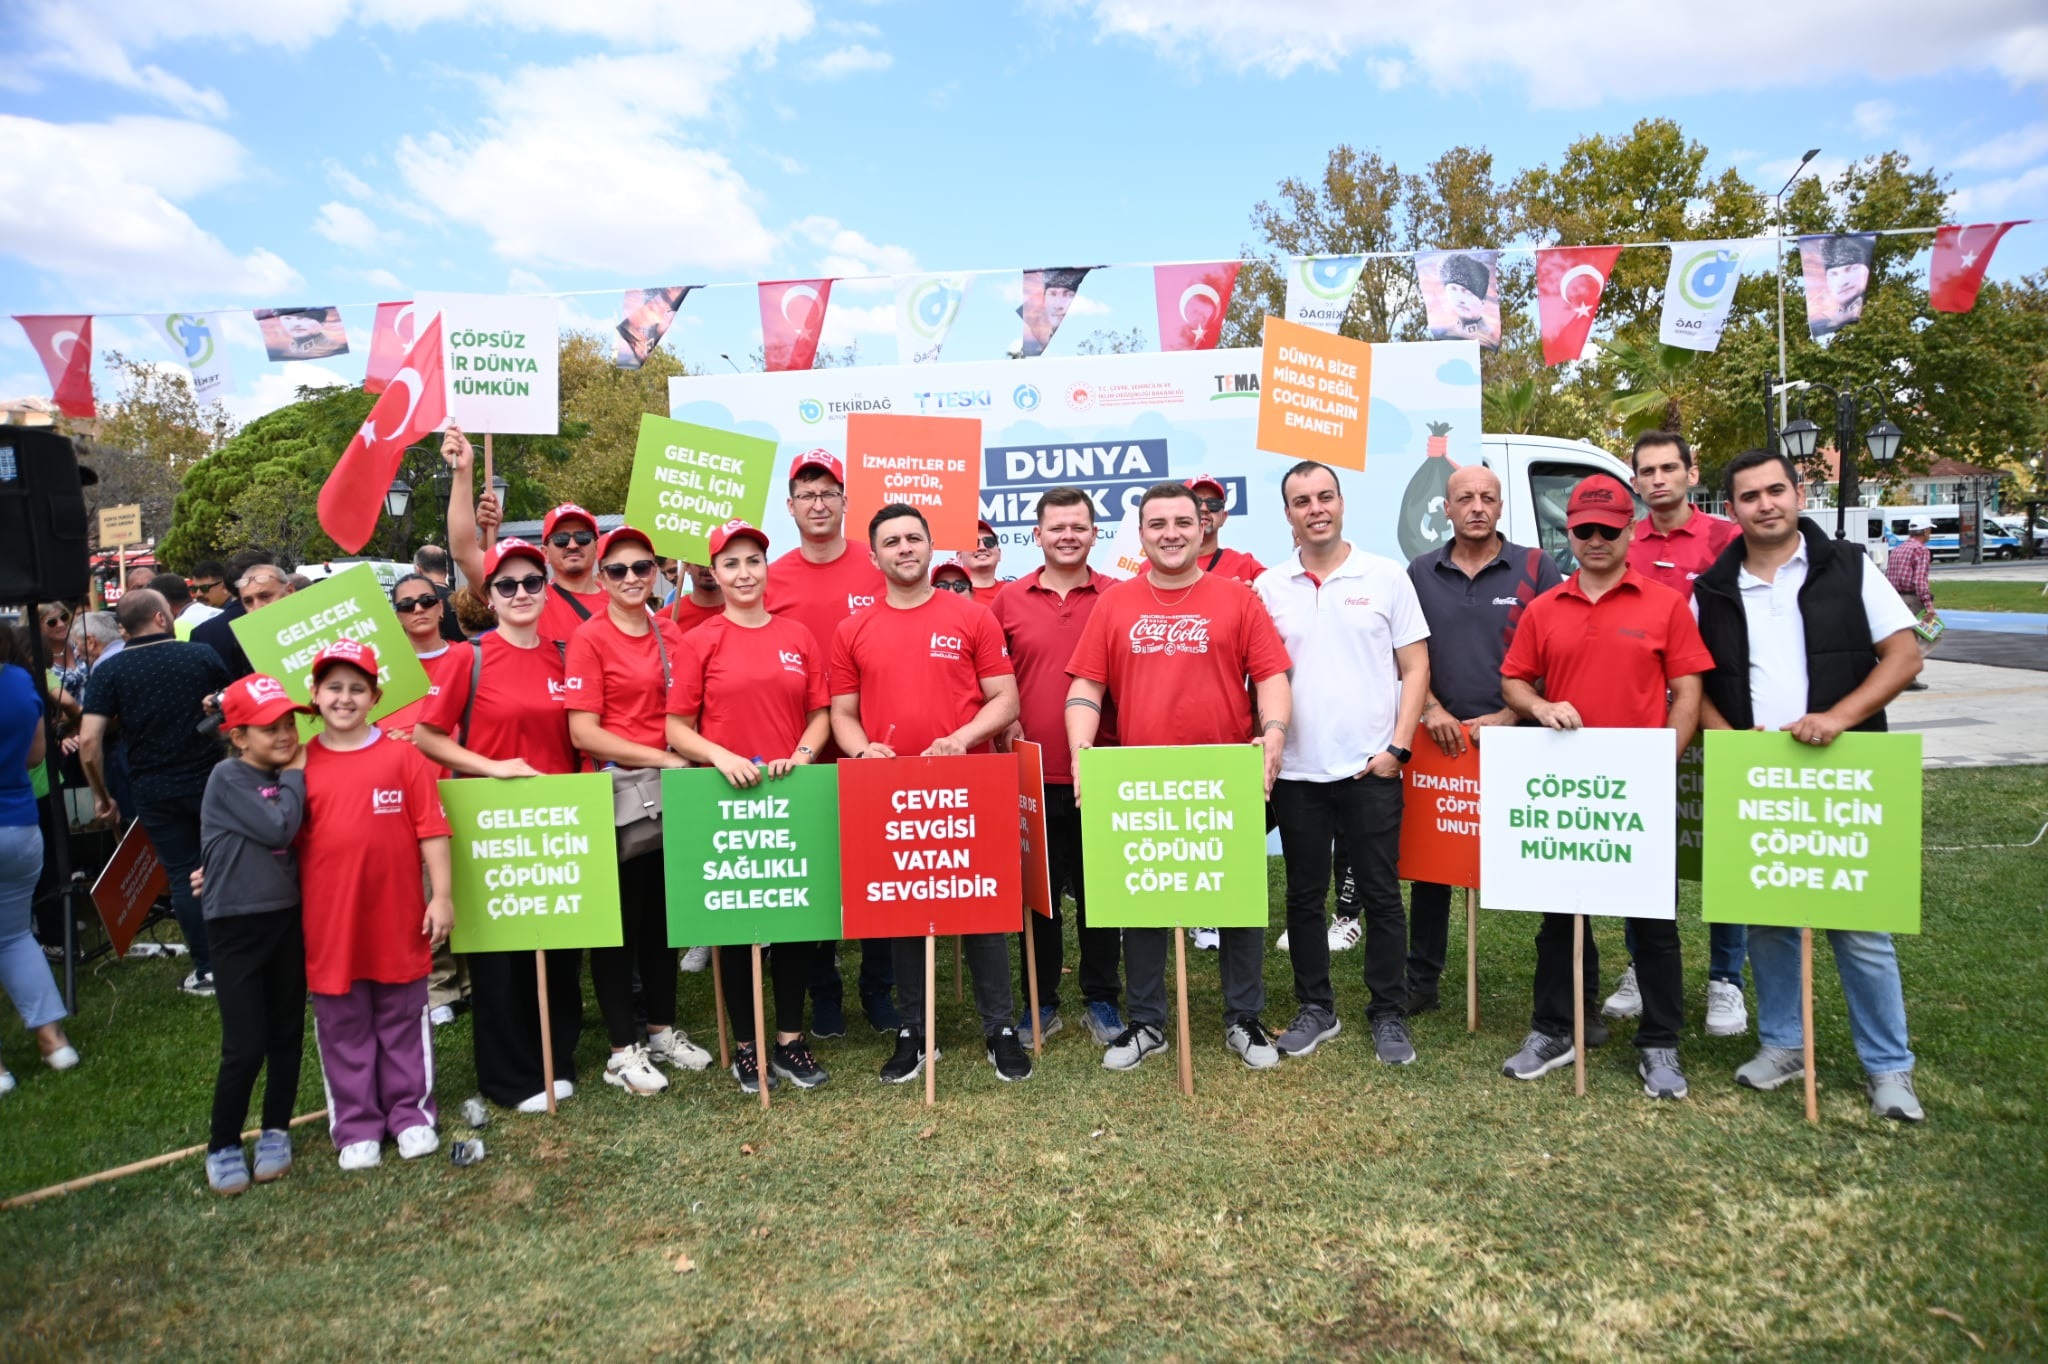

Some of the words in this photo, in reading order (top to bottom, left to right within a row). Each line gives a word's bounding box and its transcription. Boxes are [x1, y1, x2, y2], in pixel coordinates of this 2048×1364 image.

[450, 329, 526, 349] ÇÖPSÜZ
[473, 353, 538, 373] DÜNYA
[1278, 347, 1326, 371] DÜNYA
[1328, 358, 1358, 379] BİZE
[1214, 373, 1260, 393] TEMA
[1273, 366, 1316, 389] MİRAS
[1317, 377, 1360, 402] DEĞİL,
[828, 396, 892, 413] TEKİRDAĞ
[1272, 387, 1359, 421] ÇOCUKLARIN
[1284, 411, 1345, 438] EMANETİ
[664, 444, 745, 476] GELECEK
[862, 453, 944, 471] İZMARİTLER
[947, 459, 966, 472] DE
[1005, 445, 1152, 481] DÜNYA
[654, 465, 704, 491] NESİL
[708, 474, 745, 499] İÇİN
[883, 472, 943, 490] ÇÖPTÜR,
[658, 489, 734, 520] ÇÖPÜNÜ
[883, 492, 943, 506] UNUTMA
[654, 512, 703, 537] ÇÖPE
[276, 597, 362, 647] GELECEK
[1118, 780, 1226, 801] GELECEK
[1526, 774, 1627, 800] ÇÖPSÜZ
[1747, 766, 1874, 791] GELECEK
[718, 795, 789, 820] TEMİZ
[891, 788, 969, 813] ÇEVRE
[1738, 796, 1818, 822] NESİL
[1824, 797, 1883, 827] İÇİN
[477, 806, 580, 830] GELECEK
[885, 814, 976, 841] SEVGİSİ
[1112, 807, 1180, 832] NESİL
[1185, 806, 1234, 834] İÇİN
[1509, 804, 1549, 829] BİR
[1557, 806, 1645, 832] DÜNYA
[472, 834, 537, 859] NESİL
[542, 832, 589, 859] İÇİN
[712, 829, 797, 854] ÇEVRE,
[1123, 837, 1224, 865] ÇÖPÜNÜ
[1521, 836, 1632, 863] MÜMKÜN
[1750, 828, 1869, 858] ÇÖPÜNÜ
[702, 855, 808, 881] SAĞLIKLI
[892, 848, 970, 871] VATAN
[484, 861, 580, 891] ÇÖPÜNÜ
[866, 874, 998, 902] SEVGİSİDİR
[1125, 868, 1188, 895] ÇÖPE
[1194, 872, 1225, 892] AT
[1750, 861, 1825, 890] ÇÖPE
[1831, 868, 1869, 892] AT
[487, 893, 549, 920] ÇÖPE
[553, 894, 582, 914] AT
[704, 887, 809, 911] GELECEK
